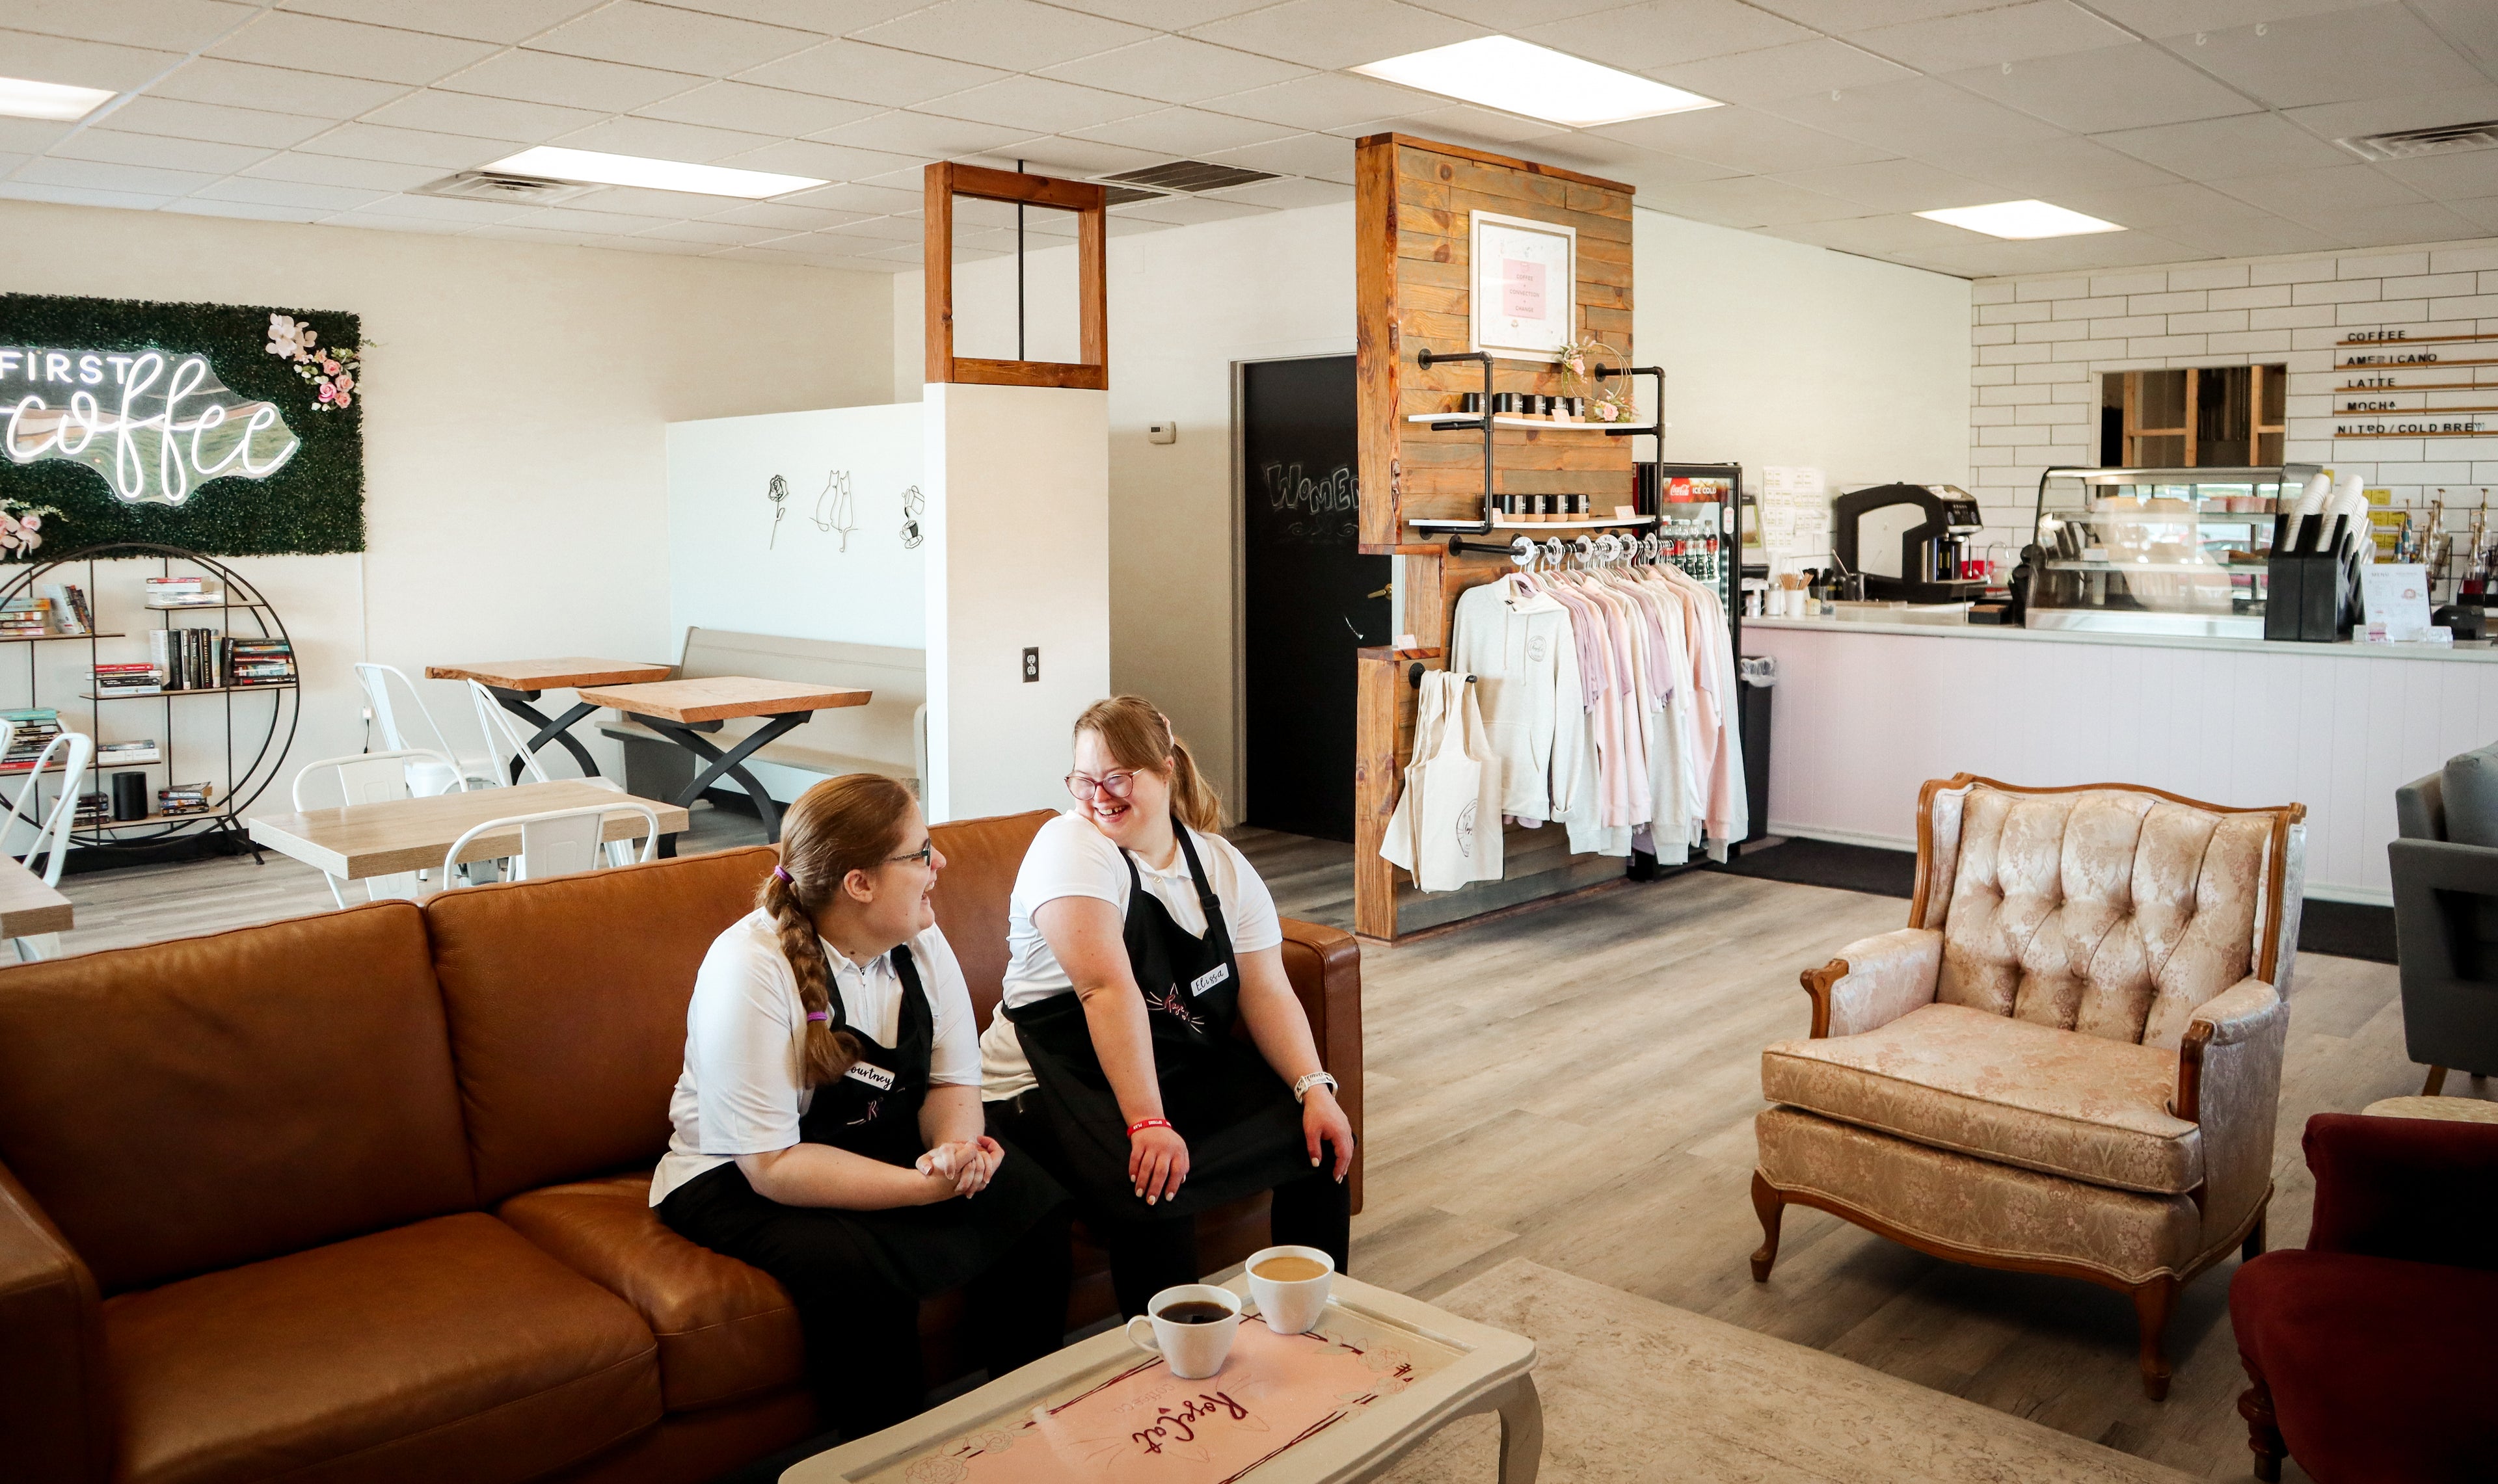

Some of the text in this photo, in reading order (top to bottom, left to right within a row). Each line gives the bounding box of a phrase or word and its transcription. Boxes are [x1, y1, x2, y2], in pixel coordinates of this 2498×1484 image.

[1509, 289, 1539, 297] CONNECTION
[2347, 330, 2406, 342] COFFEE
[2346, 353, 2438, 365] AMERICANO
[0, 352, 134, 385] FIRST
[2348, 377, 2396, 388] LATTE
[2346, 401, 2397, 411] MOCHA
[5, 352, 297, 501] coffee
[2443, 422, 2485, 432] BREW
[1195, 969, 1224, 992] Elissa
[850, 1065, 894, 1089] ourtney
